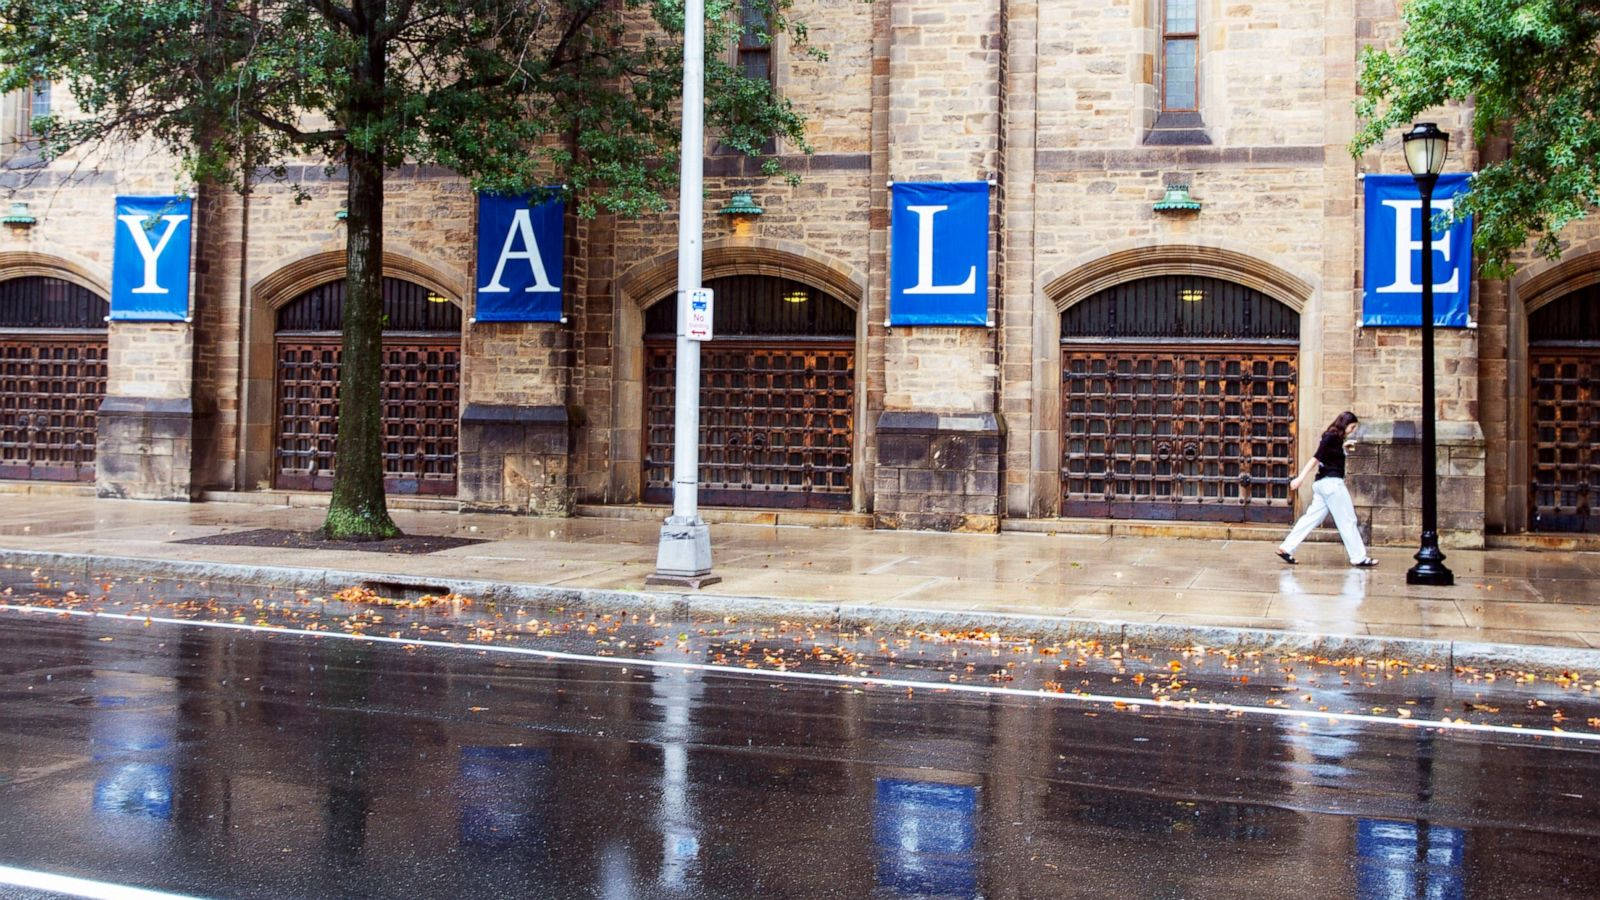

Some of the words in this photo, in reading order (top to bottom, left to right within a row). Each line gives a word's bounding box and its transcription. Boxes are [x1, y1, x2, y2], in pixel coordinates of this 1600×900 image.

[118, 215, 188, 294] Y
[478, 209, 560, 293] A
[903, 205, 976, 294] L
[1376, 199, 1459, 293] E
[694, 313, 704, 322] No
